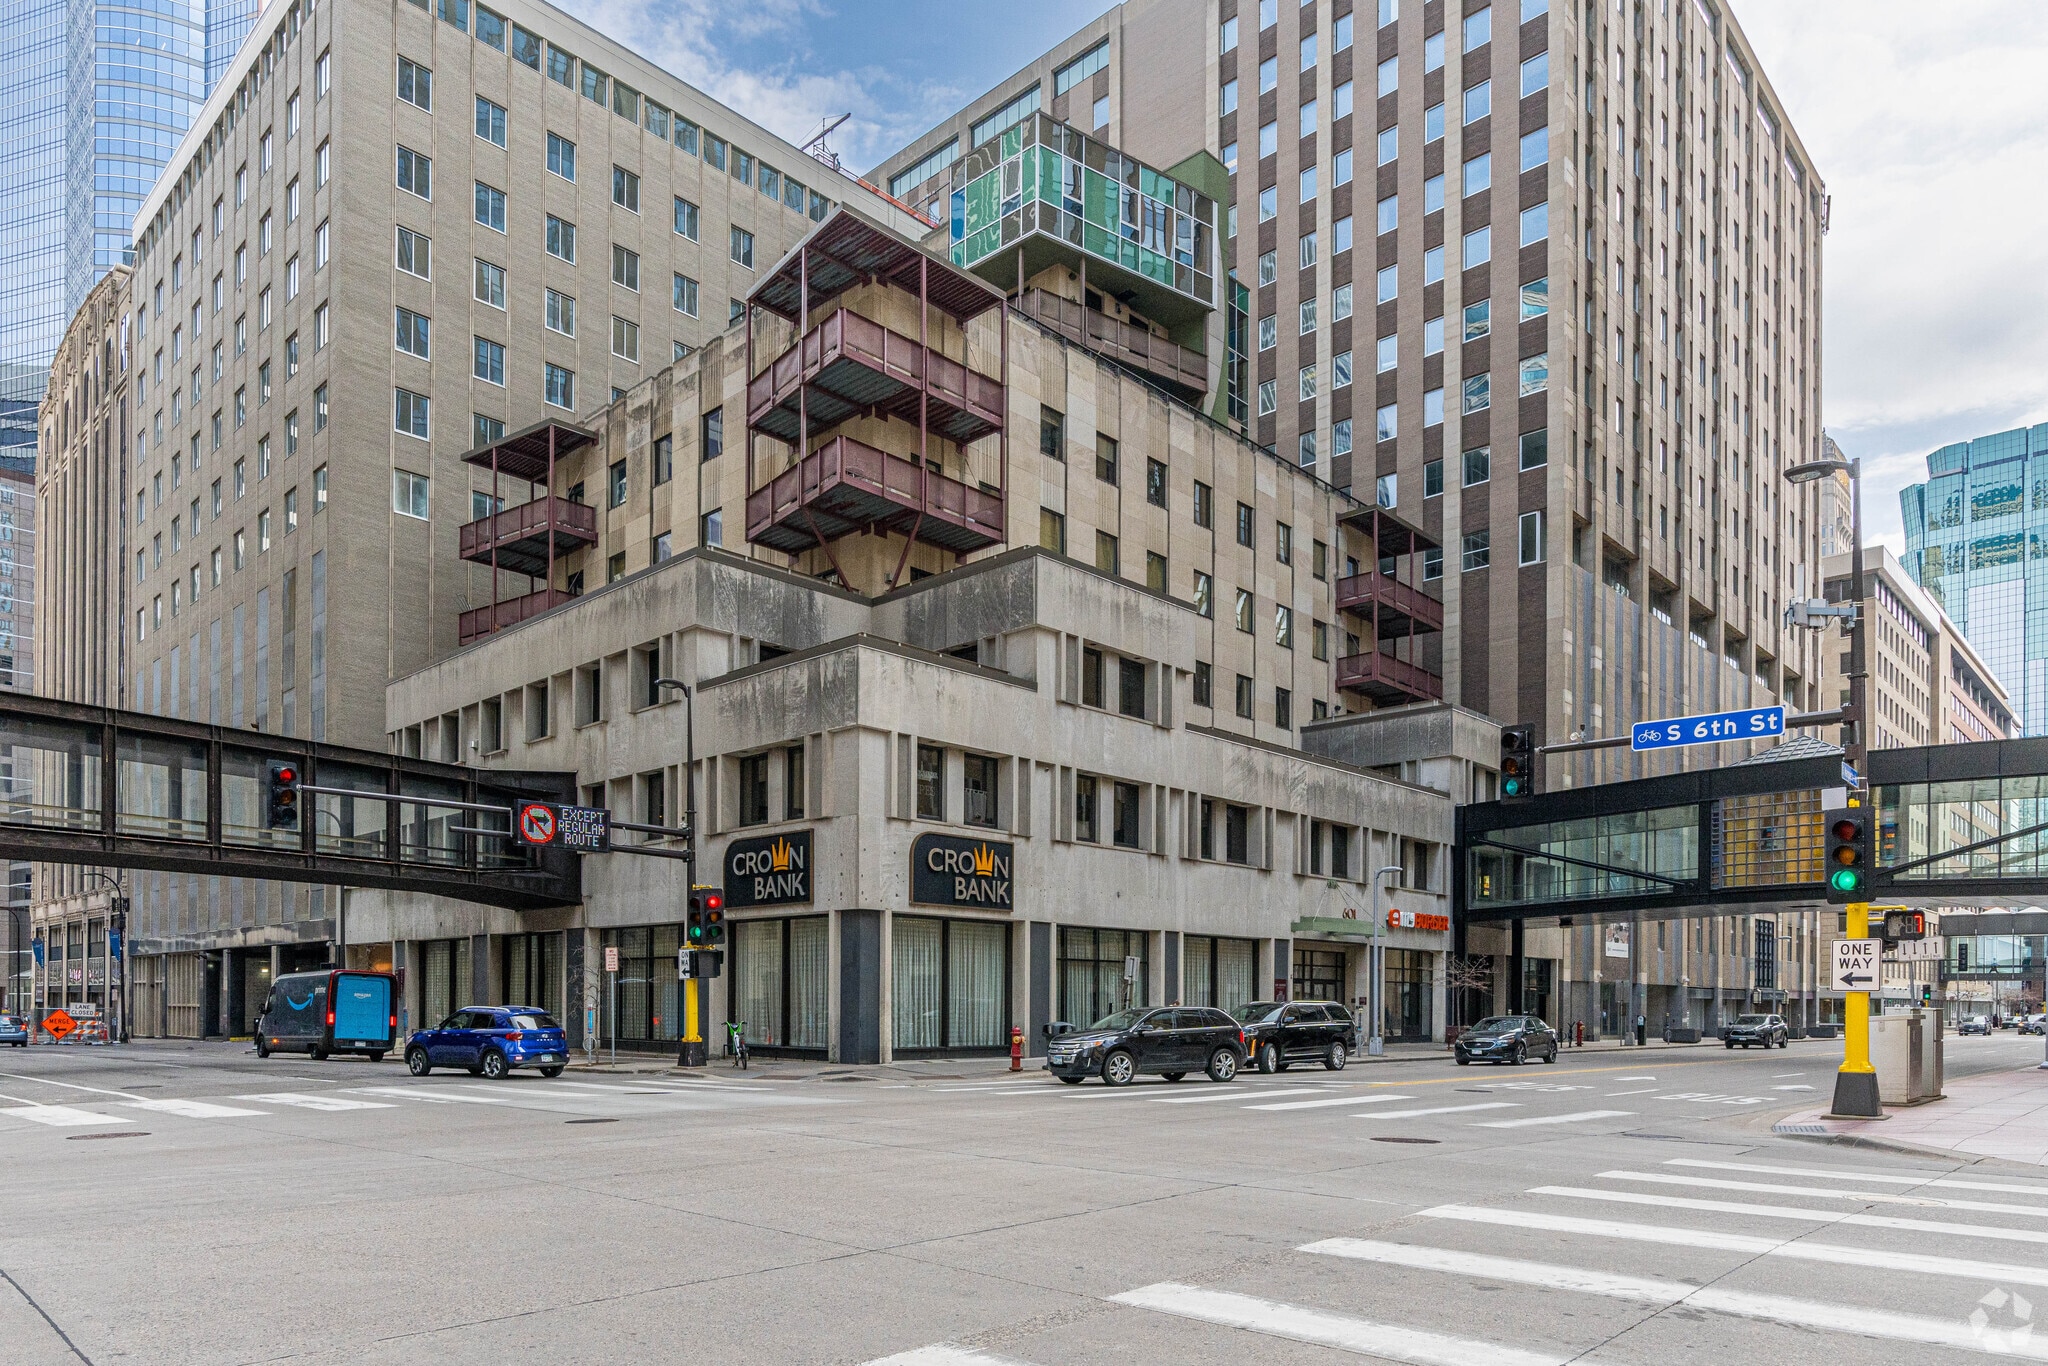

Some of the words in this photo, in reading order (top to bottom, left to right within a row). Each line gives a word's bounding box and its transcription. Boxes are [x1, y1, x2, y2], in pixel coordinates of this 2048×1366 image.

[1667, 724, 1681, 741] S
[1693, 718, 1737, 738] 6th
[1750, 713, 1778, 732] St
[562, 808, 605, 823] EXCEPT
[558, 820, 605, 836] REGULAR
[564, 833, 600, 847] ROUTE
[754, 872, 806, 900] BANK
[955, 876, 1010, 904] BANK
[1342, 907, 1357, 920] 601
[1840, 943, 1872, 956] ONE
[1839, 957, 1873, 970] WAY
